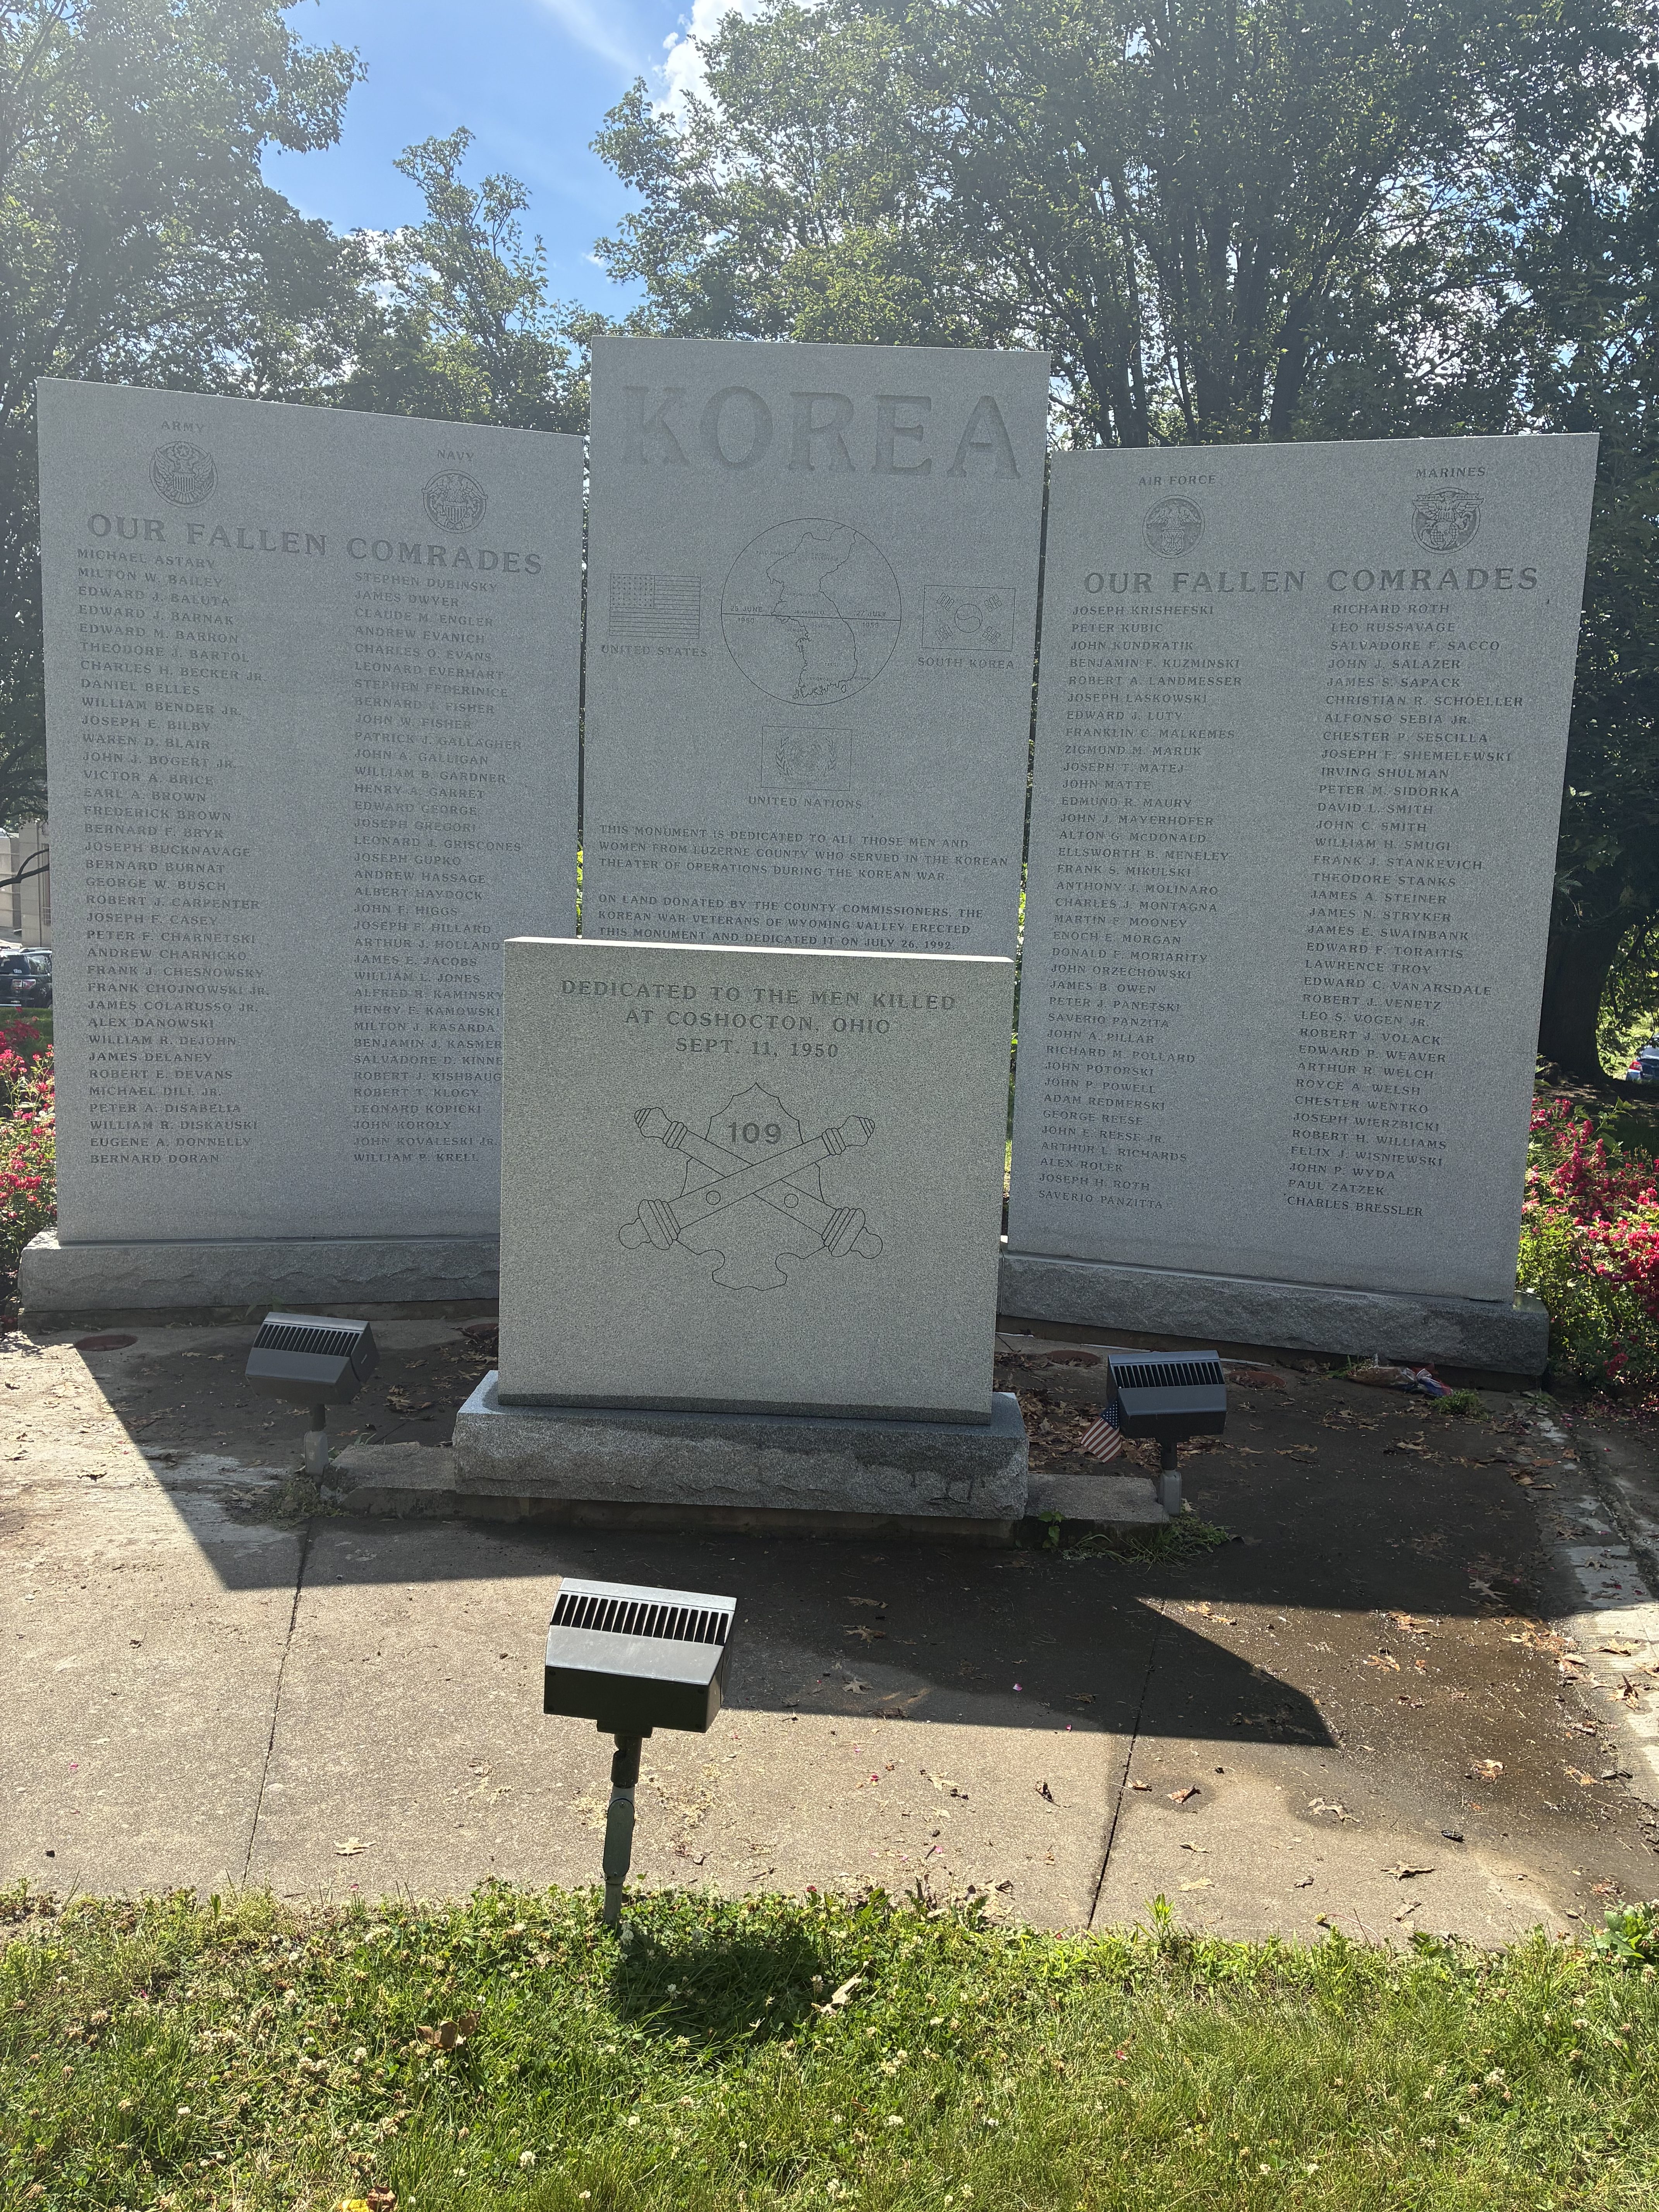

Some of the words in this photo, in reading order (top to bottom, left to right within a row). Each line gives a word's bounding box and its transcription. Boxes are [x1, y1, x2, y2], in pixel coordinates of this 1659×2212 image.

[161, 421, 204, 433] ARMY
[621, 385, 1022, 479] KOREA
[438, 450, 474, 462] NAVY
[1416, 467, 1486, 478] MARINES
[1138, 477, 1161, 486] AIR
[1169, 475, 1217, 485] FORCE
[88, 514, 166, 542] OUR
[186, 522, 327, 556] FALLEN
[346, 538, 542, 575] COMRADES
[77, 549, 146, 563] MICHAEL
[156, 555, 215, 568] ASTARY
[1085, 572, 1152, 594] OUR
[1173, 571, 1306, 592] FALLEN
[1328, 567, 1538, 591] COMRADES
[1333, 605, 1400, 614] RICHARD
[1408, 605, 1449, 613] ROTH
[1072, 624, 1114, 632] PETER
[1121, 624, 1163, 632] KUBIC
[1331, 623, 1358, 632] LEO
[1366, 623, 1455, 632] RUSSAVAGE
[355, 627, 416, 639] ANDREW
[423, 631, 485, 644] EVANICH
[601, 645, 650, 654] UNITED
[657, 647, 707, 657] STATES
[81, 660, 151, 674] CHARLES
[160, 666, 173, 675] H.
[180, 667, 238, 679] BECKER
[247, 671, 268, 681] JR.
[355, 661, 422, 675] LEONARD
[429, 667, 504, 680] EVERHART
[918, 657, 962, 667] SOUTH
[970, 659, 1014, 669] KOREA
[81, 679, 137, 691] DANIEL
[145, 683, 199, 695] BELLES
[1324, 714, 1392, 723] ALFONSO
[1400, 715, 1443, 724] SEBIA
[749, 796, 797, 806] UNITED
[804, 799, 862, 809] NATIONS
[600, 825, 628, 835] THIS
[634, 826, 707, 838] MONUMENT
[714, 830, 723, 838] IS
[731, 830, 802, 842] DEDICATED
[809, 833, 825, 843] TO
[832, 834, 852, 843] ALL
[862, 835, 903, 845] THOSE
[909, 837, 935, 847] MEN
[942, 838, 968, 848] AND
[354, 854, 407, 864] JOSEPH
[415, 855, 461, 866] GUPKO
[599, 842, 646, 852] WOMEN
[653, 844, 687, 854] FROM
[694, 845, 750, 856] LUZERNE
[757, 848, 808, 858] COUNTY
[816, 850, 843, 859] WHO
[850, 852, 899, 862] SERVED
[906, 854, 917, 862] IN
[924, 855, 948, 864] THE
[955, 856, 1007, 866] KOREAN
[86, 860, 157, 871] BERNARD
[165, 863, 225, 873] BURNAT
[599, 859, 658, 869] THEATER
[665, 861, 680, 870] OF
[687, 862, 767, 874] OPERATIONS
[775, 866, 821, 876] DURING
[828, 868, 852, 877] THE
[859, 869, 910, 879] KOREAN
[86, 878, 146, 888] GEORGE
[155, 880, 170, 889] W.
[177, 881, 226, 891] BUSCH
[355, 871, 414, 881] ANDREW
[422, 873, 486, 884] HASSAGE
[599, 894, 616, 903] ON
[623, 895, 657, 905] LAND
[663, 897, 723, 907] DONATED
[730, 899, 746, 908] BY
[754, 900, 778, 909] THE
[784, 902, 836, 912] COUNTY
[843, 904, 951, 916] COMMISSIONERS,
[958, 908, 983, 917] THE
[1056, 898, 1116, 908] CHARLES
[1123, 900, 1132, 909] J.
[1139, 901, 1218, 912] MONTAGNA
[599, 911, 651, 921] KOREAN
[658, 914, 685, 923] WAR
[692, 915, 759, 926] VETERANS
[766, 918, 781, 926] OF
[788, 919, 850, 929] WYOMING
[857, 921, 905, 931] VALLEY
[912, 923, 970, 934] ERECTED
[1310, 908, 1355, 918] JAMES
[1383, 911, 1451, 922] STRYKER
[599, 927, 627, 937] THIS
[634, 929, 706, 940] MONUMENT
[713, 932, 738, 941] AND
[745, 933, 817, 944] DEDICATED
[823, 936, 835, 945] IT
[842, 937, 858, 946] ON
[864, 938, 894, 947] JULY
[902, 939, 918, 948] 26,
[924, 940, 954, 950] 1992.
[354, 955, 398, 965] JAMES
[407, 957, 417, 965] E.
[424, 957, 477, 966] JACOBS
[1305, 960, 1384, 972] LAWRENCE
[1393, 964, 1431, 974] TROY
[561, 980, 697, 999] DEDICATED
[711, 986, 739, 1001] TO
[754, 988, 798, 1003] THE
[811, 991, 859, 1006] MEN
[873, 993, 955, 1010] KILLED
[354, 1022, 406, 1031] MILTON
[413, 1023, 423, 1031] J.
[429, 1024, 495, 1032] KASARDA
[625, 1010, 653, 1024] AT
[666, 1012, 819, 1030] COSHOCTON,
[832, 1018, 890, 1033] OHIO
[676, 1038, 739, 1054] SEPT.
[752, 1041, 777, 1055] 11,
[791, 1042, 838, 1058] 1950
[89, 1053, 137, 1061] JAMES
[145, 1053, 212, 1062] DELANEY
[89, 1070, 149, 1079] ROBERT
[156, 1070, 168, 1079] E.
[175, 1071, 233, 1079] DEVANS
[1295, 1096, 1359, 1108] CHESTER
[1367, 1101, 1428, 1113] WENTKO
[1043, 1110, 1095, 1122] GEORGE
[1102, 1115, 1143, 1125] REESE
[727, 1121, 781, 1144] 109
[1042, 1126, 1075, 1137] JOHN
[1100, 1130, 1140, 1141] REESE
[1289, 1180, 1324, 1190] PAUL
[1331, 1183, 1384, 1195] ZATZEK
[1039, 1190, 1092, 1202] SAVERIO
[1101, 1195, 1162, 1208] PANZITTA
[1287, 1197, 1348, 1210] CHARLES
[1356, 1202, 1423, 1216] BRESSLER
